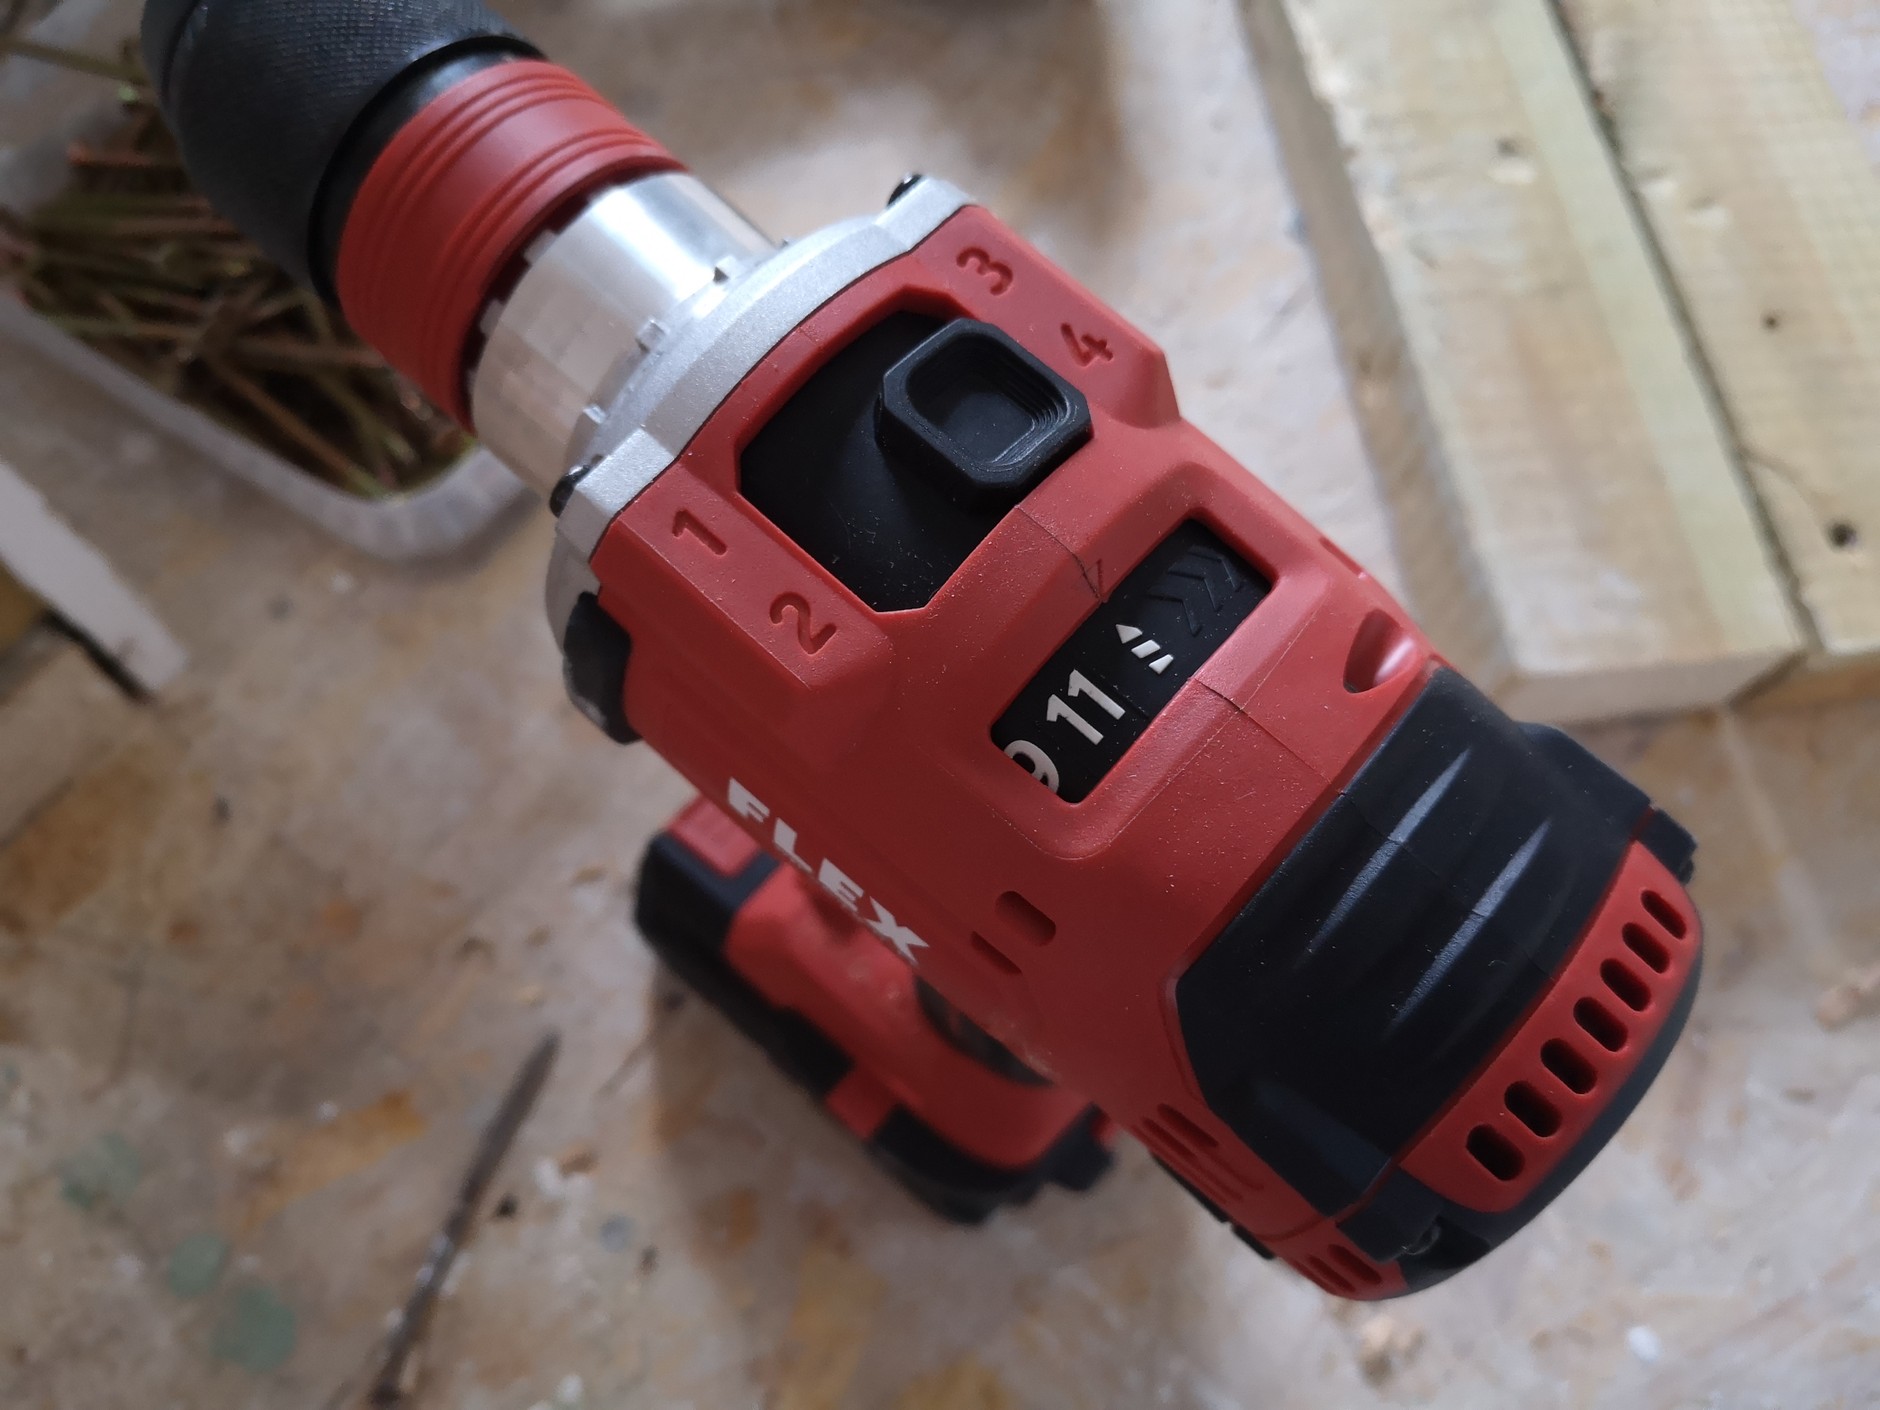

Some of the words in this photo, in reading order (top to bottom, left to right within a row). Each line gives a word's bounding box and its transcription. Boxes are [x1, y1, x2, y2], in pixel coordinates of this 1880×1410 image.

[955, 246, 1014, 296] 3
[1059, 322, 1114, 368] 4
[671, 508, 728, 556] 1
[768, 591, 837, 656] 2
[1046, 668, 1126, 746] 11
[727, 776, 930, 967] FLEX
